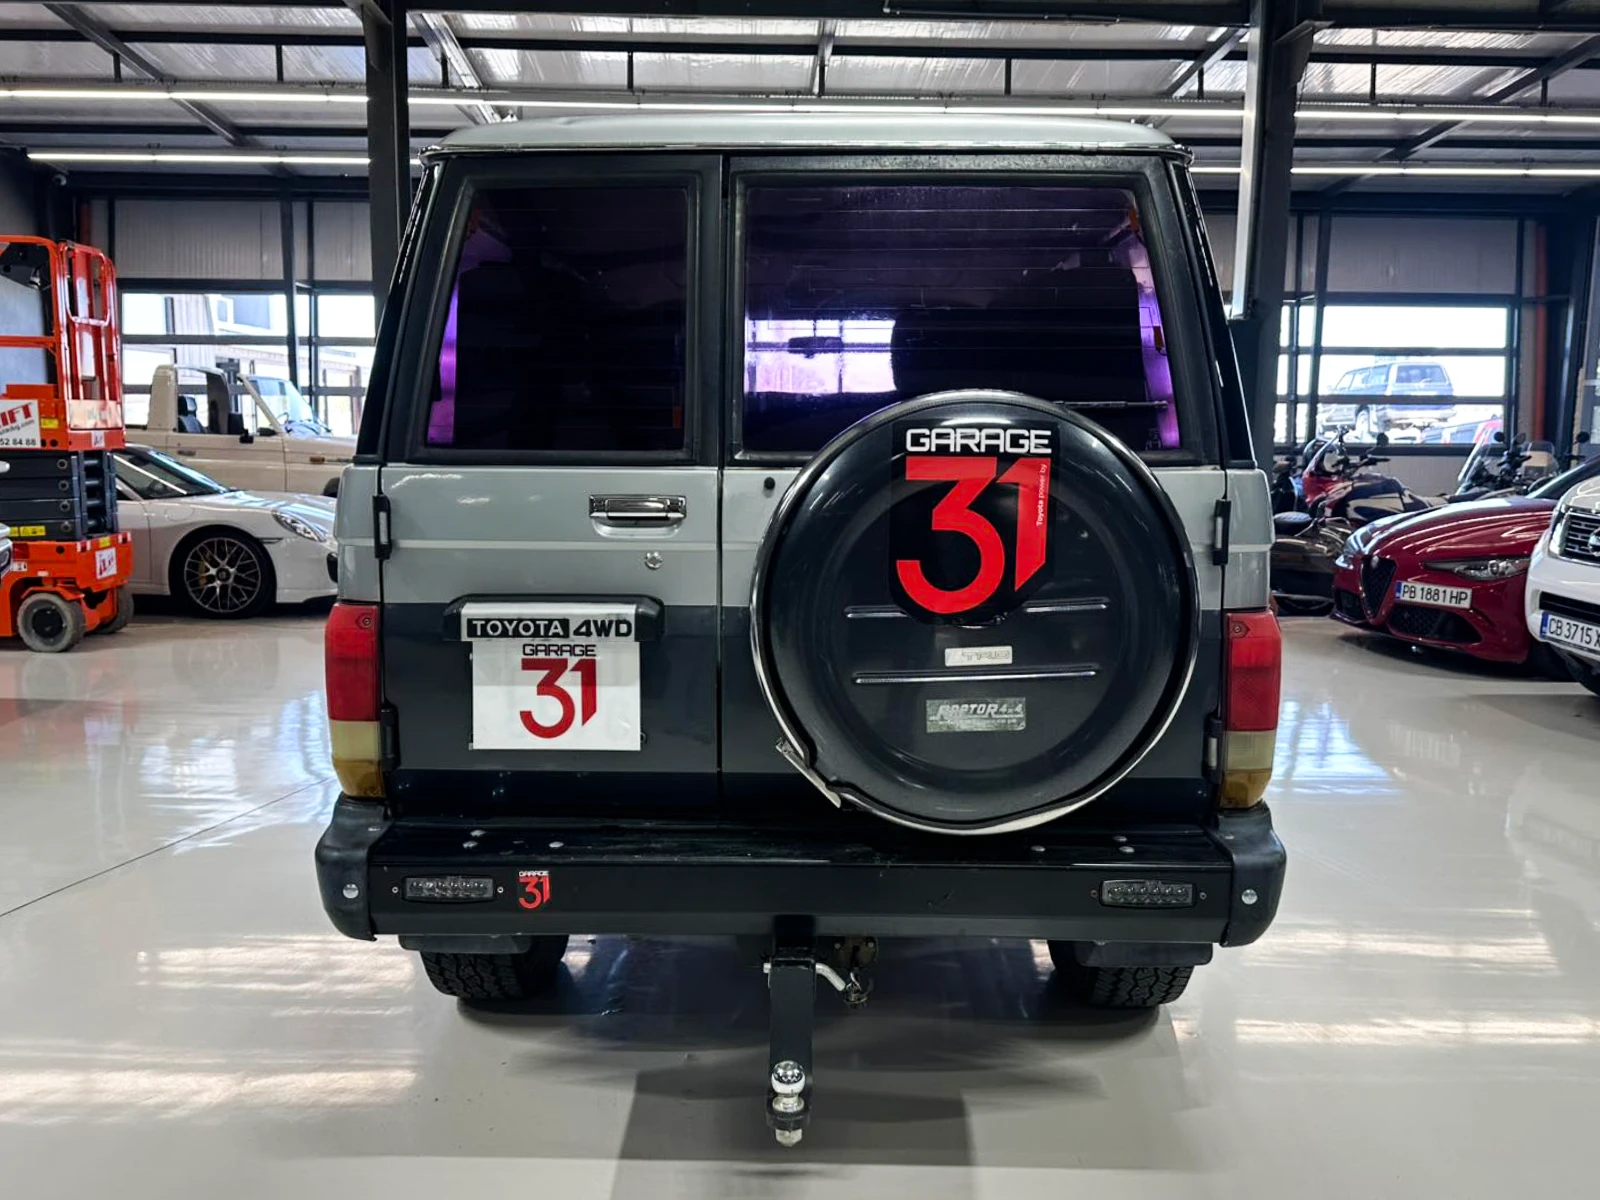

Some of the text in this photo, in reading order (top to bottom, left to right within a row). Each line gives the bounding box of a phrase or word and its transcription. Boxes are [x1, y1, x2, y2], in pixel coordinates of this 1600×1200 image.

[0, 402, 32, 427] IFT
[906, 428, 1052, 454] GARAGE
[1036, 499, 1044, 527] Toyota
[896, 456, 1052, 614] 31
[1402, 584, 1469, 605] PB 1881 HP
[472, 619, 632, 637] TOYOTA 4WD
[1549, 618, 1563, 636] CB
[1564, 622, 1593, 645] 3715
[522, 643, 597, 657] GARAGE
[520, 657, 597, 739] 31
[519, 876, 550, 909] 31
